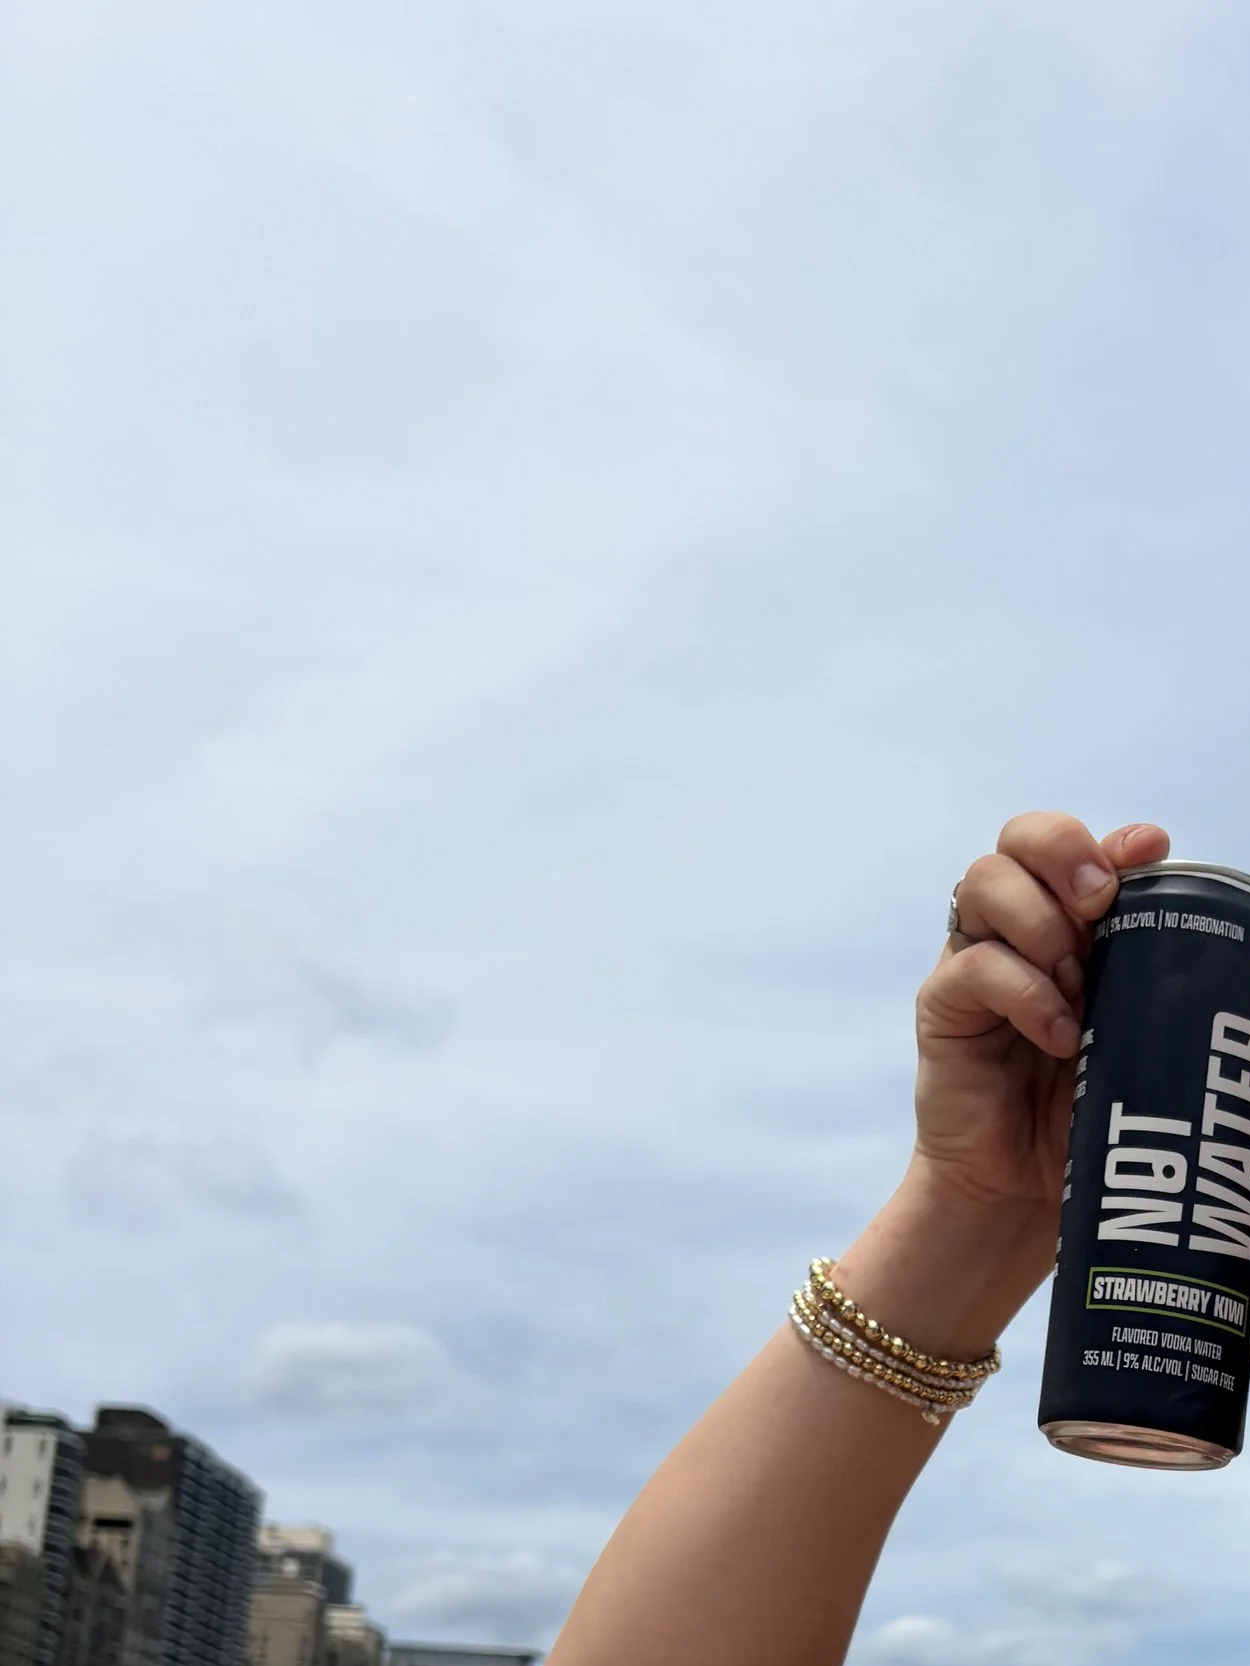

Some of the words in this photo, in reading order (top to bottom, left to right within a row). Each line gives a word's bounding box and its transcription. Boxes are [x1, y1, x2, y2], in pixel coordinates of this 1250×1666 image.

[1121, 912, 1157, 930] ALC/VOL
[1164, 911, 1179, 928] NO
[1180, 913, 1245, 942] CARBONATION
[1097, 1102, 1192, 1247] NOT
[1093, 1276, 1211, 1314] STRAWBERRY
[1213, 1294, 1245, 1326] KIWI
[1111, 1326, 1158, 1347] FLAVORED
[1160, 1332, 1192, 1353] VODKA
[1194, 1339, 1222, 1361] WATER
[1082, 1350, 1100, 1366] 355
[1100, 1350, 1115, 1367] ML
[1123, 1353, 1139, 1370] 9%
[1141, 1355, 1183, 1377] ALC/VOL
[1191, 1363, 1219, 1387] SUGAR
[1219, 1371, 1236, 1392] FREE
